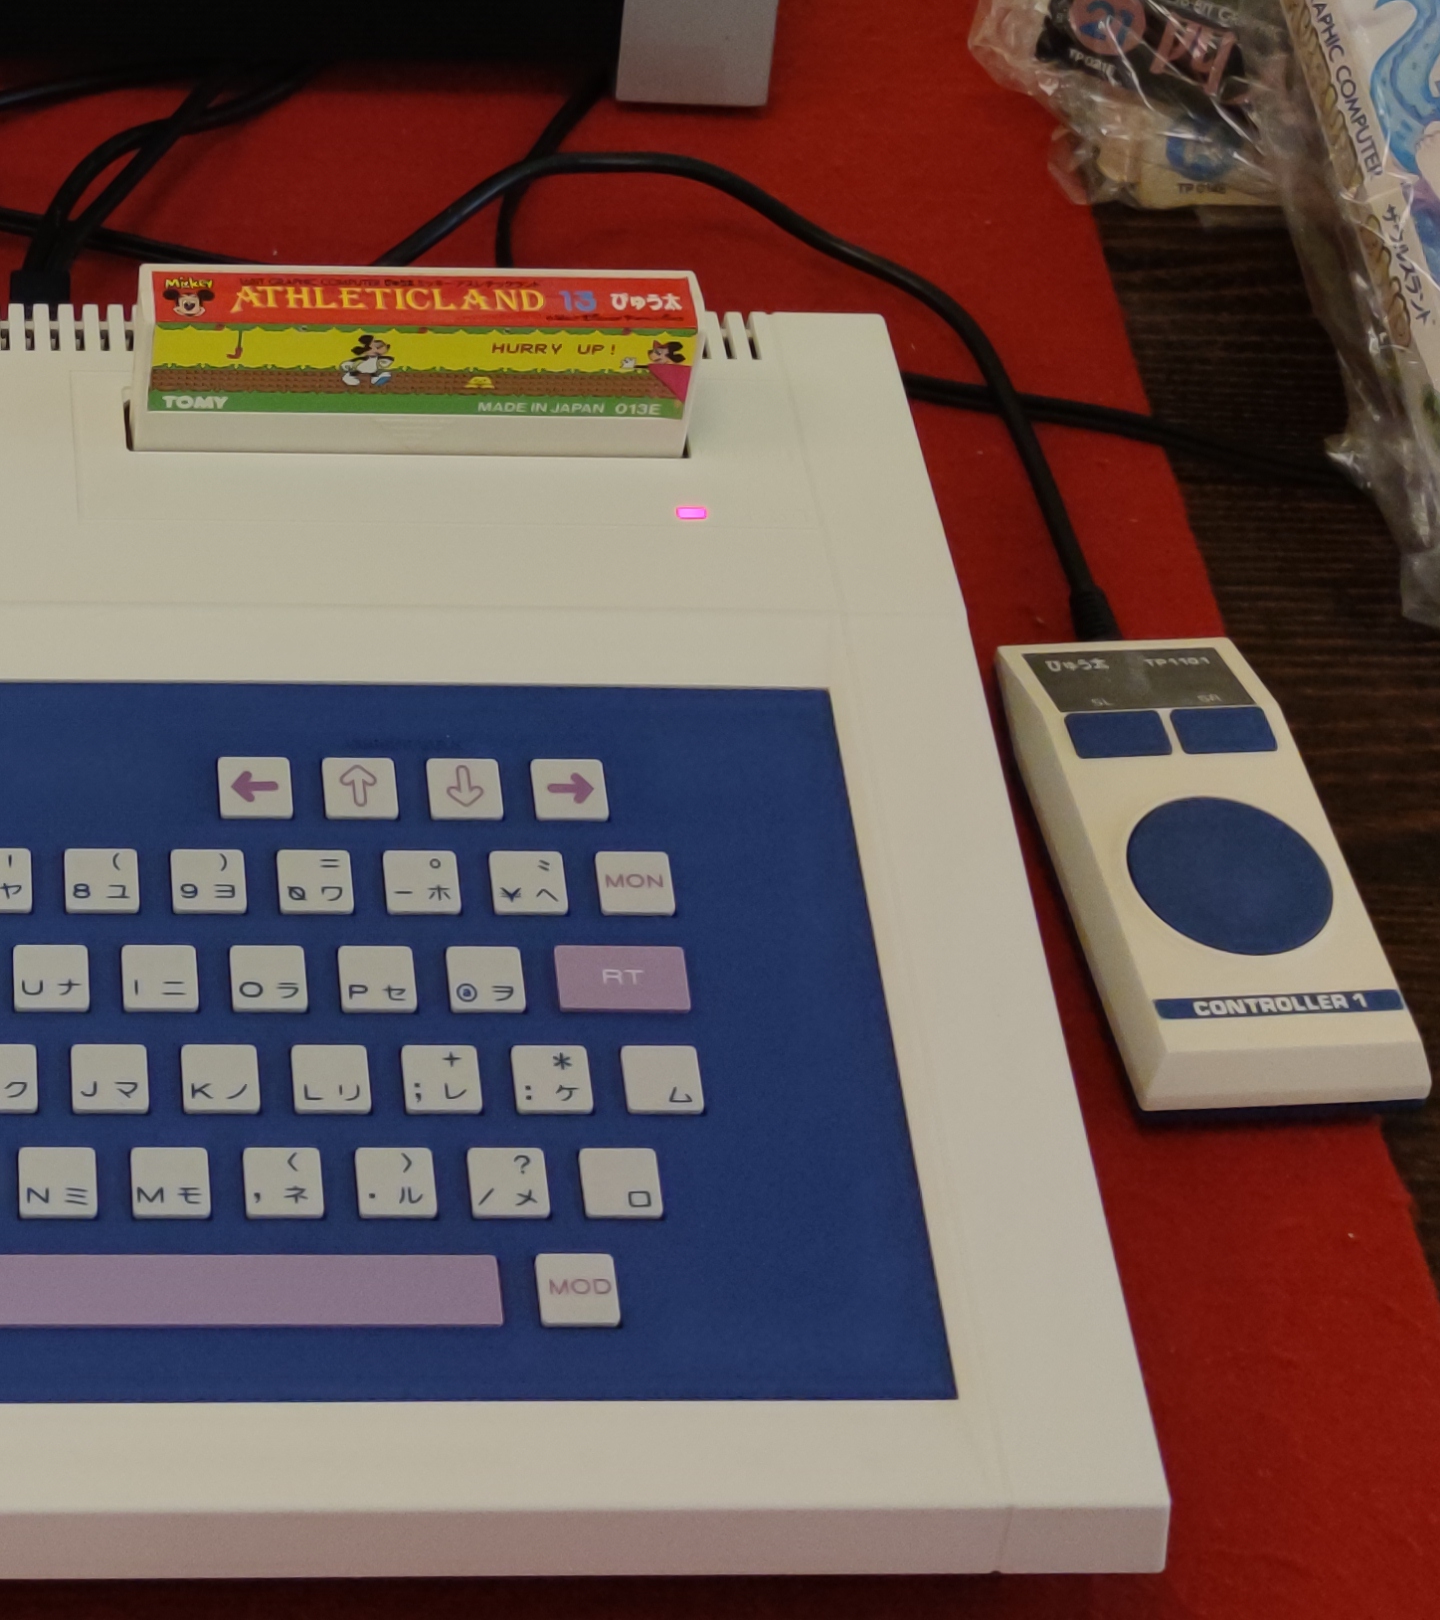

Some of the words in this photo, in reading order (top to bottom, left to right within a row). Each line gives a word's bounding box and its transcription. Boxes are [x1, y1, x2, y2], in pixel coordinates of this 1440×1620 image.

[1334, 63, 1385, 178] COMPUTER
[230, 284, 546, 314] ATHLETICLAND
[491, 343, 563, 355] HURRY
[163, 395, 229, 410] TOMY
[477, 402, 528, 413] MADE
[530, 402, 549, 413] IN
[550, 403, 606, 414] JAPAN
[605, 873, 664, 888] MON
[72, 882, 92, 900] 8
[602, 967, 643, 986] RT
[21, 979, 44, 997] U
[1193, 993, 1349, 1017] CONTROLLER
[1352, 992, 1370, 1010] 1
[190, 1082, 214, 1100] K
[136, 1186, 165, 1204] M
[548, 1278, 612, 1295] MOD
